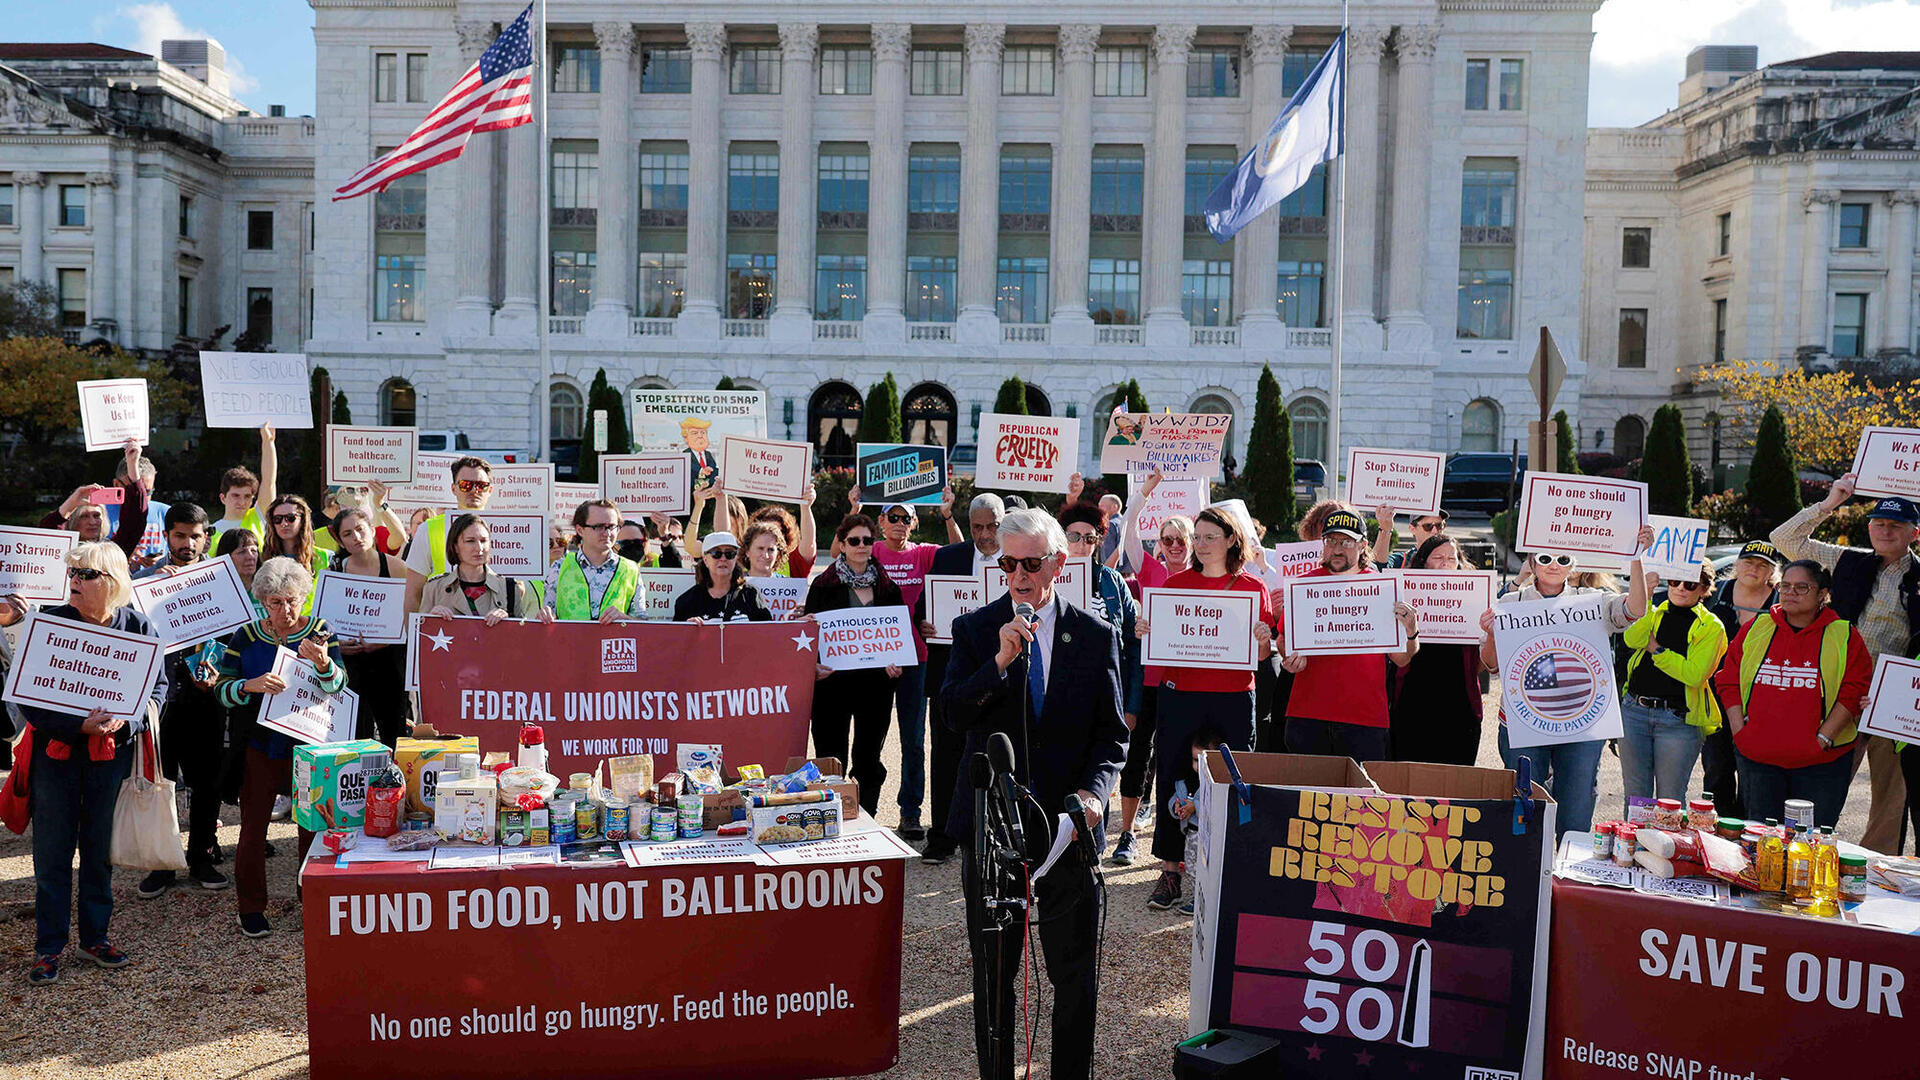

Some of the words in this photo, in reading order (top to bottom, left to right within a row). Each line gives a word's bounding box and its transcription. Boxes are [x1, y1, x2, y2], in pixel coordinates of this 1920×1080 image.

[209, 357, 241, 380] WE
[249, 359, 306, 380] SHOULD
[211, 392, 252, 412] FEED
[259, 392, 309, 415] PEOPLE
[664, 395, 710, 404] SITTING
[730, 396, 758, 404] SNAP
[646, 405, 708, 414] EMERGENCY
[710, 406, 750, 414] FUNDS!
[999, 424, 1058, 436] REPUBLICAN
[996, 434, 1058, 468] CRUELTY
[1180, 442, 1191, 450] TO
[1195, 441, 1214, 450] THE
[745, 448, 758, 460] We
[760, 450, 783, 463] Keep
[616, 466, 635, 475] Fund
[638, 466, 657, 475] food
[660, 465, 674, 474] and
[750, 464, 760, 474] Us
[764, 466, 778, 476] Fed
[868, 456, 916, 483] FAMILIES
[920, 462, 932, 472] OVER
[1126, 460, 1130, 470] I
[1164, 463, 1188, 472] NOT!
[1364, 460, 1386, 472] Stop
[1390, 462, 1430, 476] Starving
[888, 471, 936, 494] BILLIONAIRES
[998, 472, 1006, 480] IS
[1010, 472, 1024, 481] THE
[1028, 473, 1053, 482] POINT
[1376, 477, 1415, 489] Families
[498, 488, 531, 498] Families
[614, 496, 628, 504] not
[631, 494, 674, 504] ballrooms.
[1548, 485, 1562, 497] No
[1566, 488, 1586, 499] one
[1590, 489, 1626, 502] should
[1554, 506, 1568, 516] go
[1572, 505, 1612, 521] hungry
[1327, 514, 1358, 528] SPIRIT
[490, 524, 510, 534] food
[514, 524, 530, 534] and
[1550, 522, 1560, 532] in
[1564, 522, 1614, 537] America.
[1746, 544, 1775, 555] SPIRIT
[0, 560, 45, 574] Families
[150, 587, 164, 598] No
[166, 583, 182, 594] one
[185, 571, 216, 586] should
[650, 582, 672, 593] Keep
[1306, 588, 1320, 598] No
[1322, 589, 1342, 598] one
[1345, 585, 1380, 597] should
[346, 587, 358, 598] We
[362, 590, 386, 602] Keep
[954, 589, 968, 600] We
[165, 602, 178, 614] go
[178, 592, 212, 608] hungry
[348, 604, 360, 616] Us
[364, 606, 380, 616] Fed
[653, 598, 670, 608] Fed
[169, 618, 180, 628] in
[182, 606, 224, 624] America.
[1175, 604, 1190, 616] We
[1194, 605, 1222, 620] Keep
[1316, 606, 1328, 618] go
[1332, 604, 1368, 618] hungry
[1495, 609, 1556, 630] Thank
[1560, 604, 1602, 624] You!
[822, 617, 878, 630] CATHOLICS
[880, 616, 898, 624] FOR
[1182, 624, 1195, 636] Us
[1200, 624, 1218, 636] Fed
[1314, 622, 1324, 632] in
[1328, 620, 1374, 632] America.
[824, 627, 900, 643] MEDICAID
[46, 632, 78, 650] Fund
[82, 640, 110, 657] food
[113, 650, 138, 662] and
[604, 640, 634, 654] FUN
[826, 644, 860, 658] AND
[862, 640, 904, 654] SNAP
[1510, 638, 1550, 680] FEDERAL
[1552, 638, 1605, 676] WORKERS
[34, 676, 56, 688] not
[59, 678, 125, 702] ballrooms.
[1754, 674, 1790, 688] FREE
[1793, 676, 1816, 689] DC
[290, 701, 300, 714] in
[461, 690, 556, 722] FEDERAL
[564, 690, 679, 722] UNIONISTS
[686, 685, 790, 721] NETWORK
[1514, 699, 1533, 722] ARE
[1532, 716, 1562, 732] TRUE
[1564, 693, 1606, 731] PATRIOTS
[562, 739, 580, 756] WE
[584, 739, 618, 756] WORK
[622, 738, 643, 754] FOR
[648, 738, 669, 754] YOU
[340, 773, 366, 788] QUE
[340, 788, 366, 802] PASA
[1298, 790, 1482, 838] RESIST
[1286, 818, 1494, 874] REMOVE
[1269, 846, 1506, 908] RESTORE
[329, 892, 432, 936] FUND
[448, 886, 562, 930] FOOD,
[576, 881, 648, 922] NOT
[662, 866, 884, 918] BALLROOMS
[1639, 928, 1768, 995] SAVE
[1786, 952, 1906, 1018] OUR
[370, 1013, 400, 1041] No
[410, 1016, 451, 1038] one
[460, 1004, 536, 1036] should
[545, 1010, 572, 1036] go
[580, 1002, 665, 1030] hungry.
[673, 992, 724, 1022] Feed
[732, 990, 768, 1016] the
[776, 983, 855, 1020] people.
[1563, 1037, 1639, 1073] Release
[1646, 1052, 1702, 1080] SNAP
